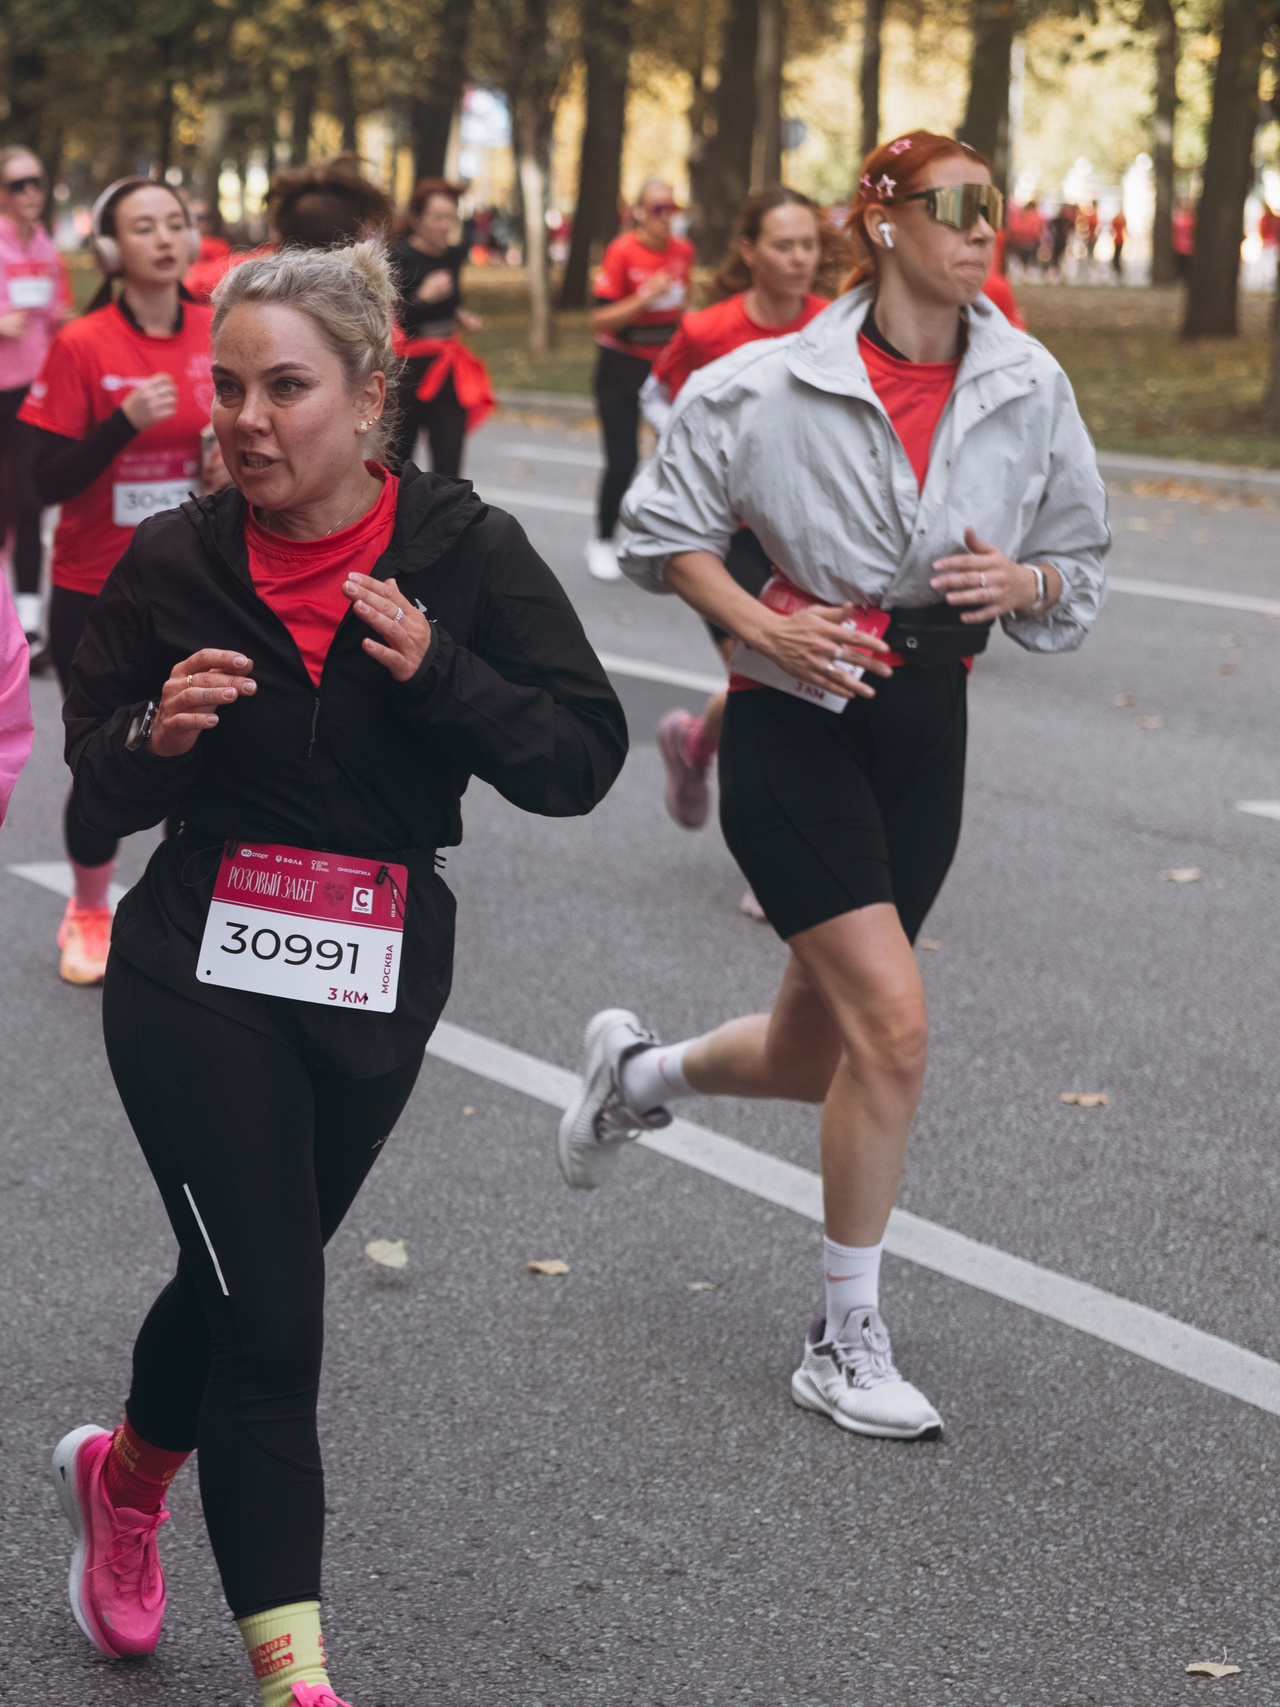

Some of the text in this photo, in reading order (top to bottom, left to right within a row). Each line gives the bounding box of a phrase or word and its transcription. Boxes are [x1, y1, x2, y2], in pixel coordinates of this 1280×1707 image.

[227, 866, 320, 903] РОЗОВЫЙ ЗАБЕГ
[220, 921, 360, 975] 30991
[381, 945, 394, 994] МОСКВА
[327, 987, 338, 1001] 3
